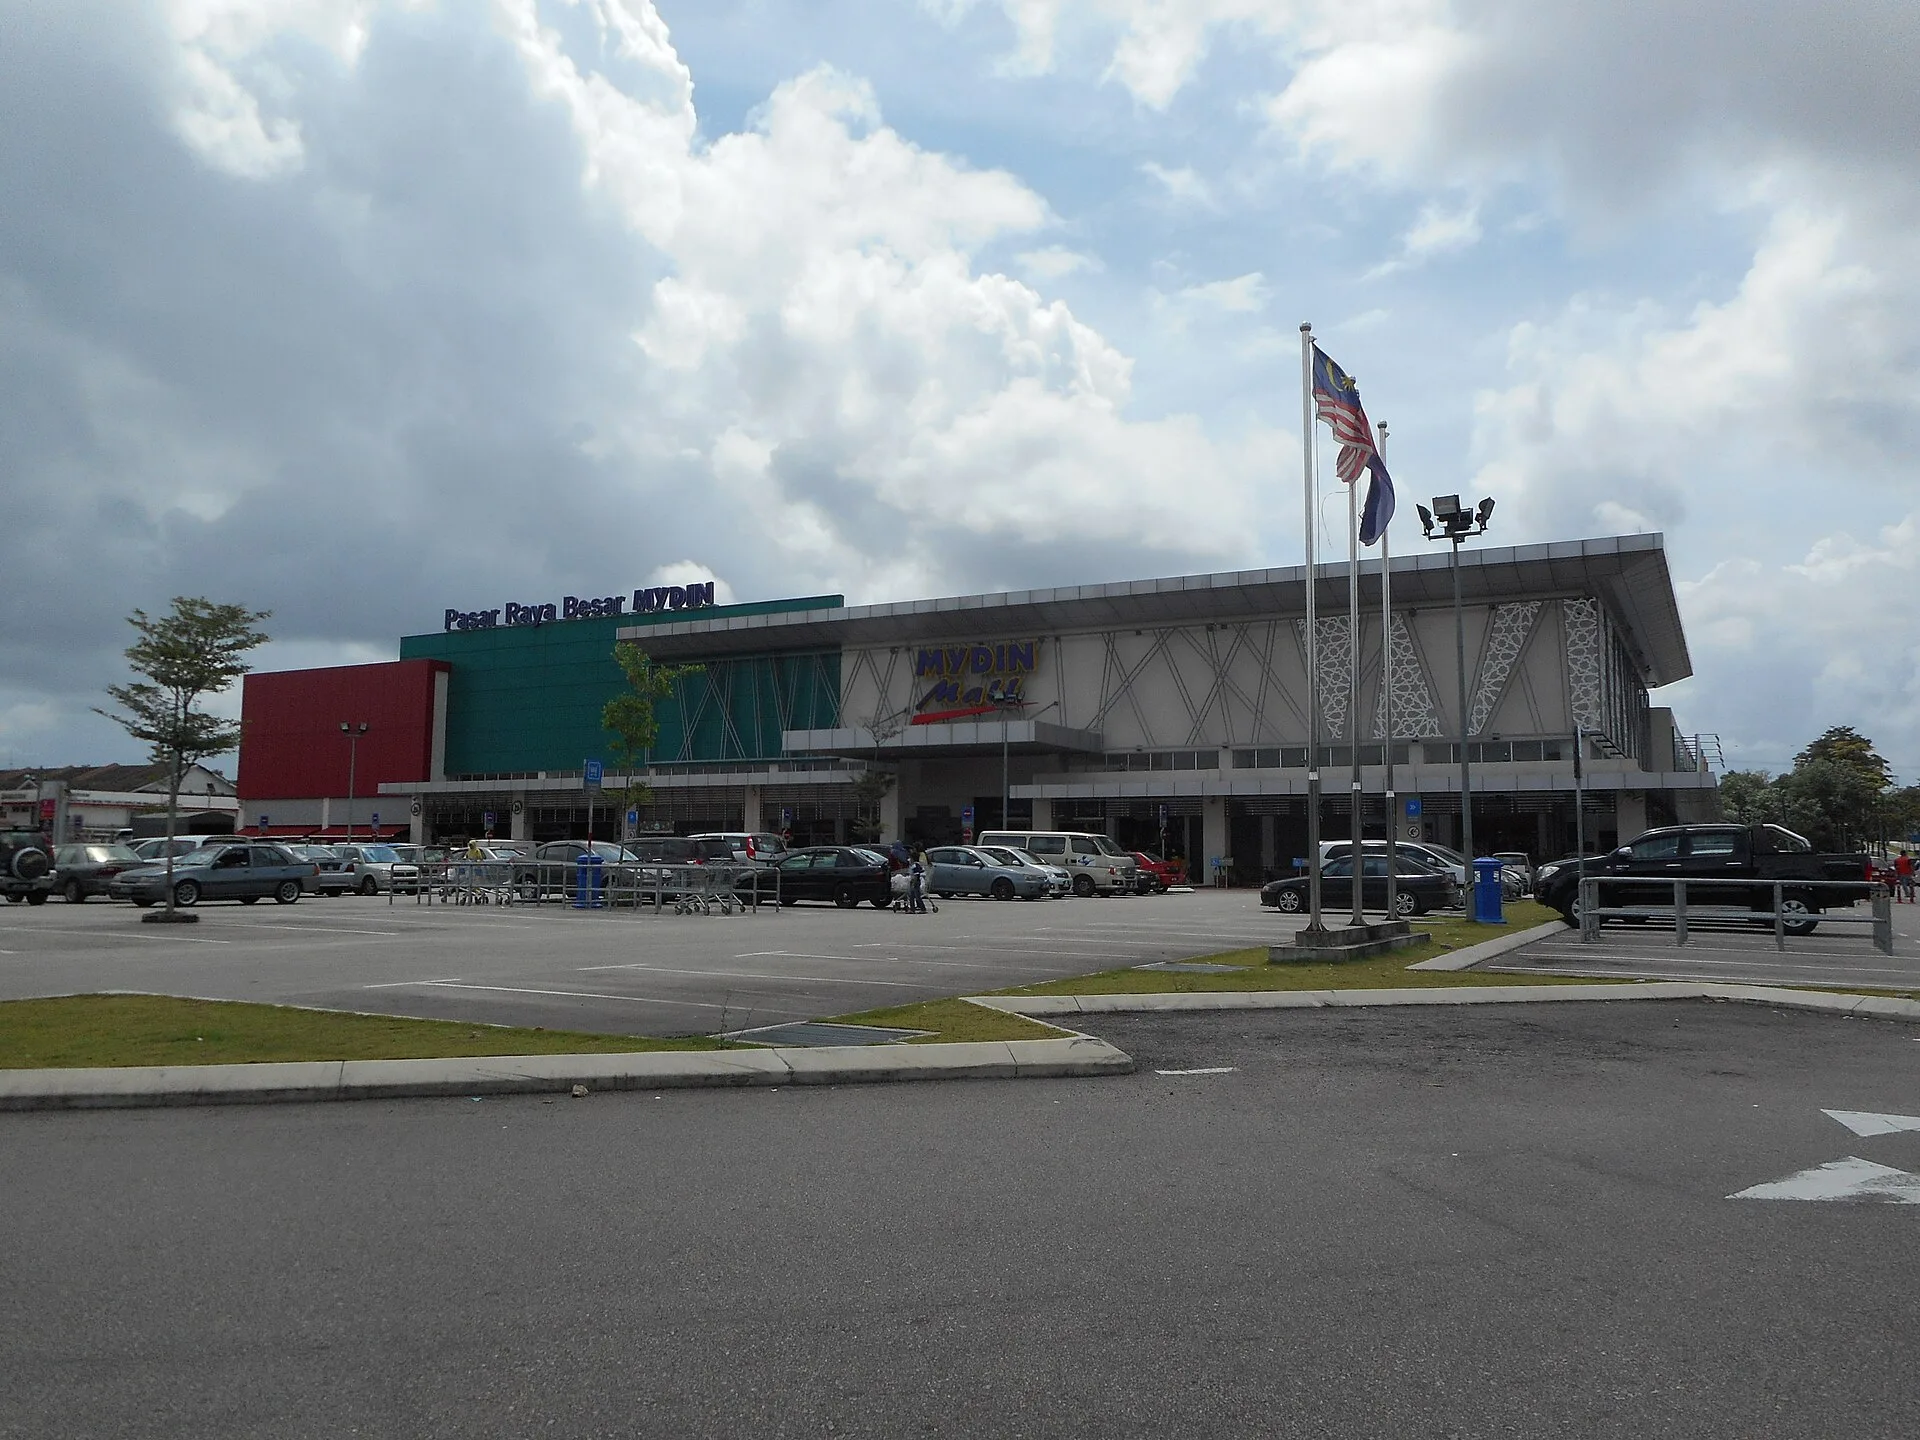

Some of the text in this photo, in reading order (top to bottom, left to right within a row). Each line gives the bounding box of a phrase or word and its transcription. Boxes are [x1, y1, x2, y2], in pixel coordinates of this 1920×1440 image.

[445, 581, 714, 630] Pasar Raya Besar MYDIN
[916, 641, 1037, 677] MYDIN
